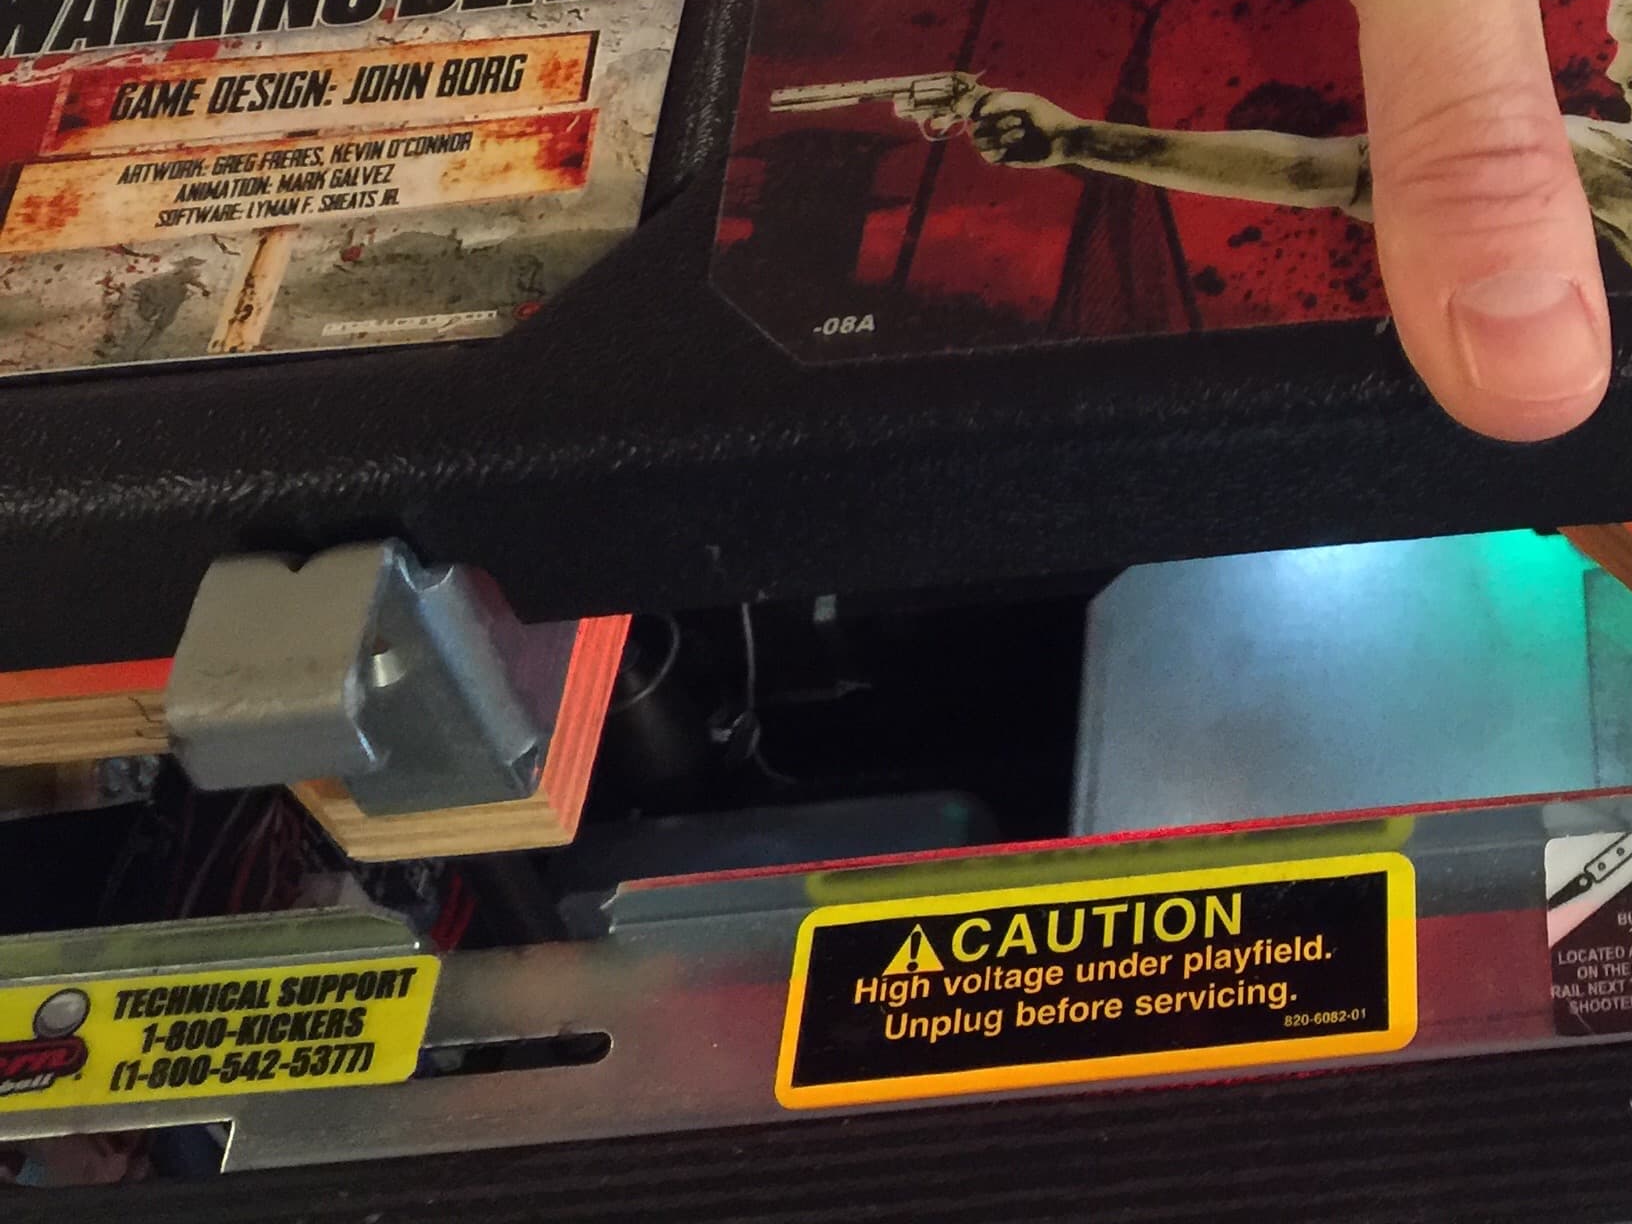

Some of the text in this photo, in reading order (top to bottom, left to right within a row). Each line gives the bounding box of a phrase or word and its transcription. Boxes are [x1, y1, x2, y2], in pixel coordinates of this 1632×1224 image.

[110, 53, 529, 122] GAME DESIGN: JOHN BORG
[116, 162, 208, 186] ARTWORK:
[211, 155, 257, 176] GREG
[258, 148, 325, 171] FRERES,
[330, 140, 386, 165] KEVIN
[173, 163, 397, 204] ANIMATION: MARK GALVEZ
[154, 204, 244, 228] SOFTWARE:
[246, 197, 301, 222] LYMAN
[301, 195, 315, 214] F.
[316, 190, 379, 214] SHEATS
[813, 314, 875, 336] -08A
[951, 892, 1244, 964] CAUTION
[853, 934, 1333, 1009] High voltage under playfield.
[1558, 945, 1625, 965] LOCATED
[1577, 965, 1599, 980] ON
[1604, 961, 1631, 978] THE
[113, 966, 418, 1021] TECHNICAL SUPPORT
[1551, 983, 1585, 999] RAIL
[1588, 979, 1625, 996] NEXT
[141, 1007, 368, 1054] 1-800-KICKERS
[883, 981, 1299, 1045] Unplug before servicing.
[1283, 1007, 1368, 1029] 820-6082-01
[108, 1041, 376, 1093] (1-800-542-5377)
